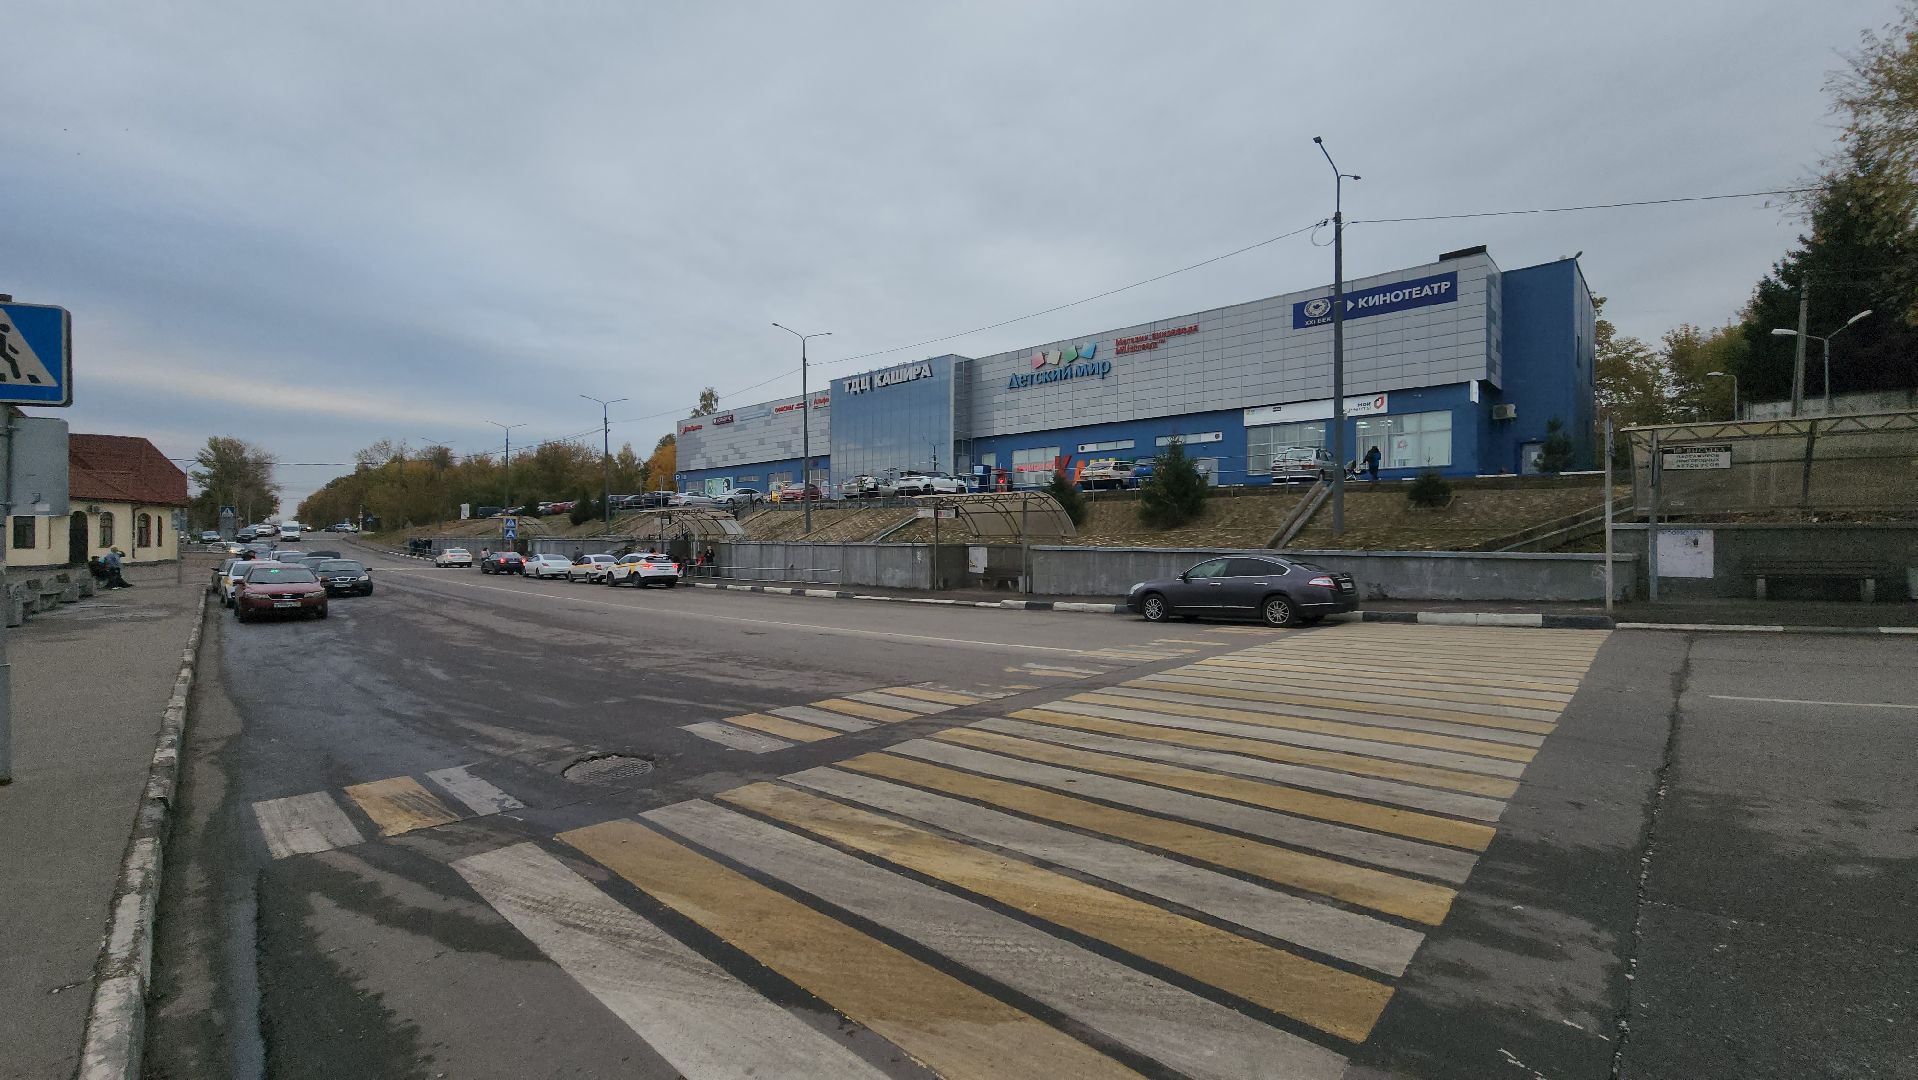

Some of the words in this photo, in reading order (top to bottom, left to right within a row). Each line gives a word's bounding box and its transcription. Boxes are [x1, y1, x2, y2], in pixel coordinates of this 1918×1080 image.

[1358, 281, 1451, 309] КИНОТЕАТР
[843, 376, 871, 394] ТДЦ
[874, 363, 933, 387] КАШИРА
[1007, 364, 1074, 389] Детский
[1075, 360, 1112, 379] мир
